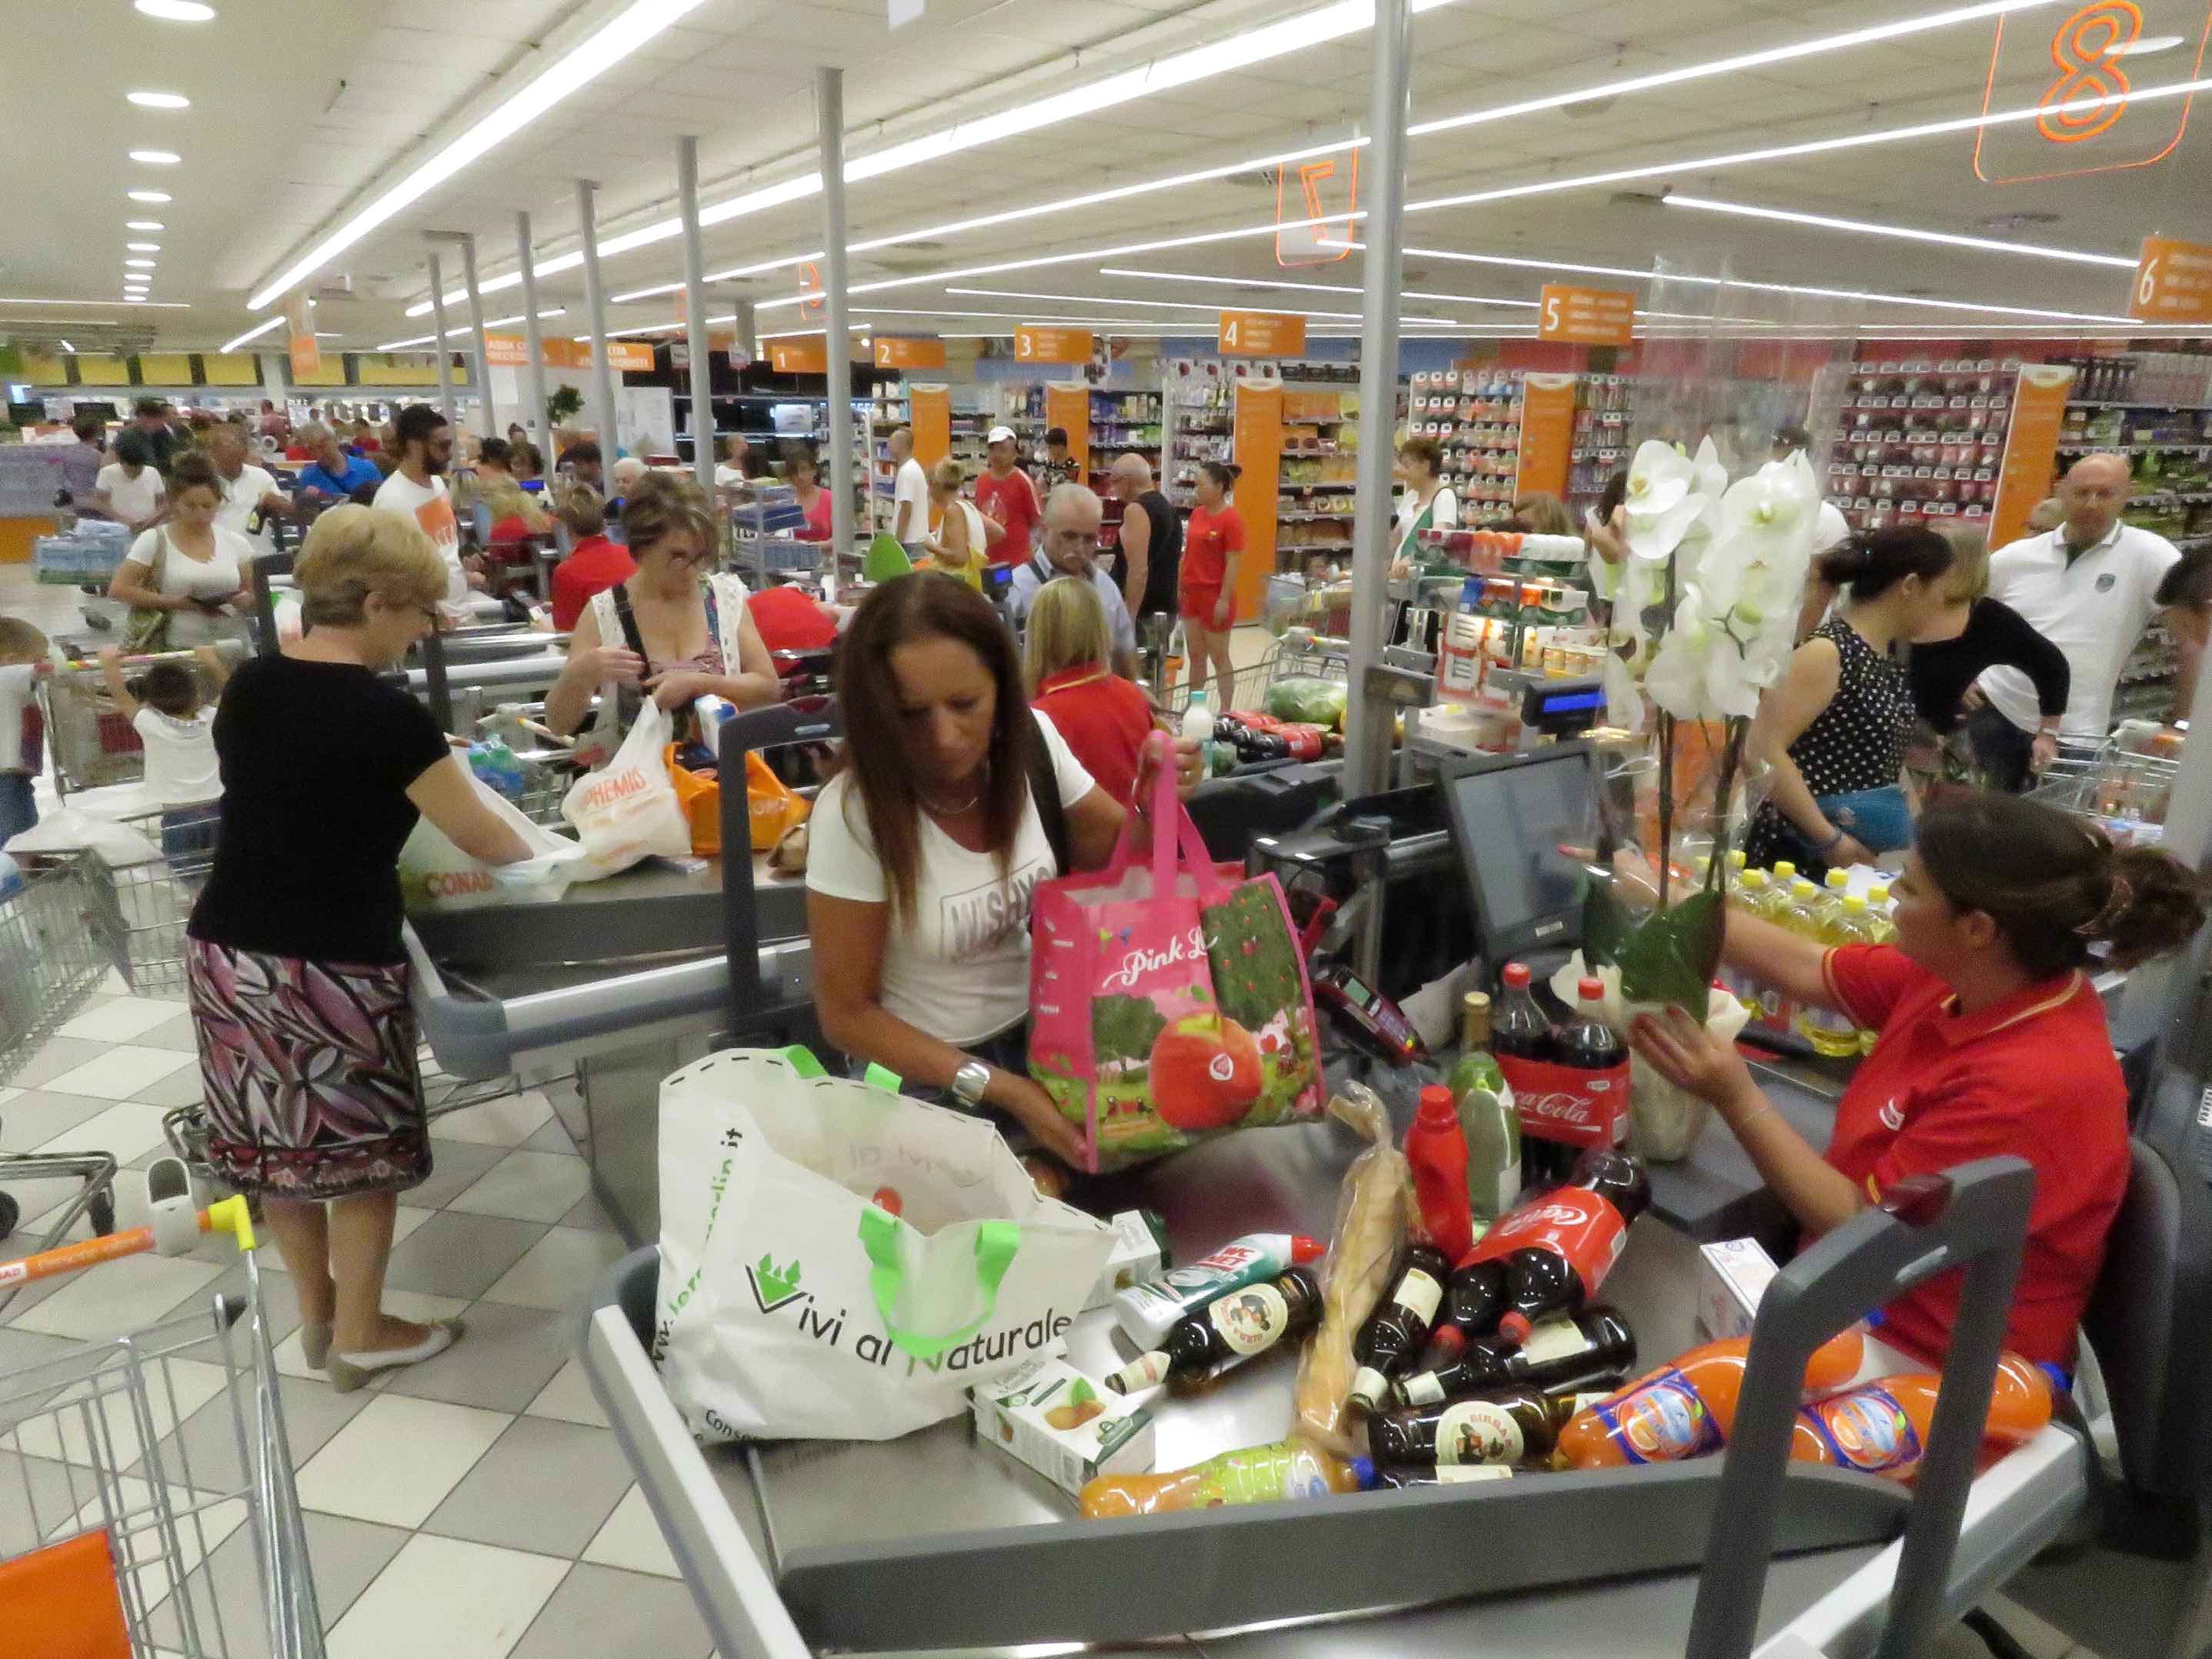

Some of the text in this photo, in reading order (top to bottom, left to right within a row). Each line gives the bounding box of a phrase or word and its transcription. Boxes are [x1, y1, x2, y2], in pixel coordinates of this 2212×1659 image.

[2036, 0, 2144, 144] 8
[2139, 258, 2158, 305] 6
[1544, 297, 1561, 332] 5
[1020, 334, 1032, 357] 3
[1224, 320, 1238, 347] 4
[778, 352, 786, 369] 1
[879, 344, 891, 364] 2
[1103, 935, 1185, 989] Pink
